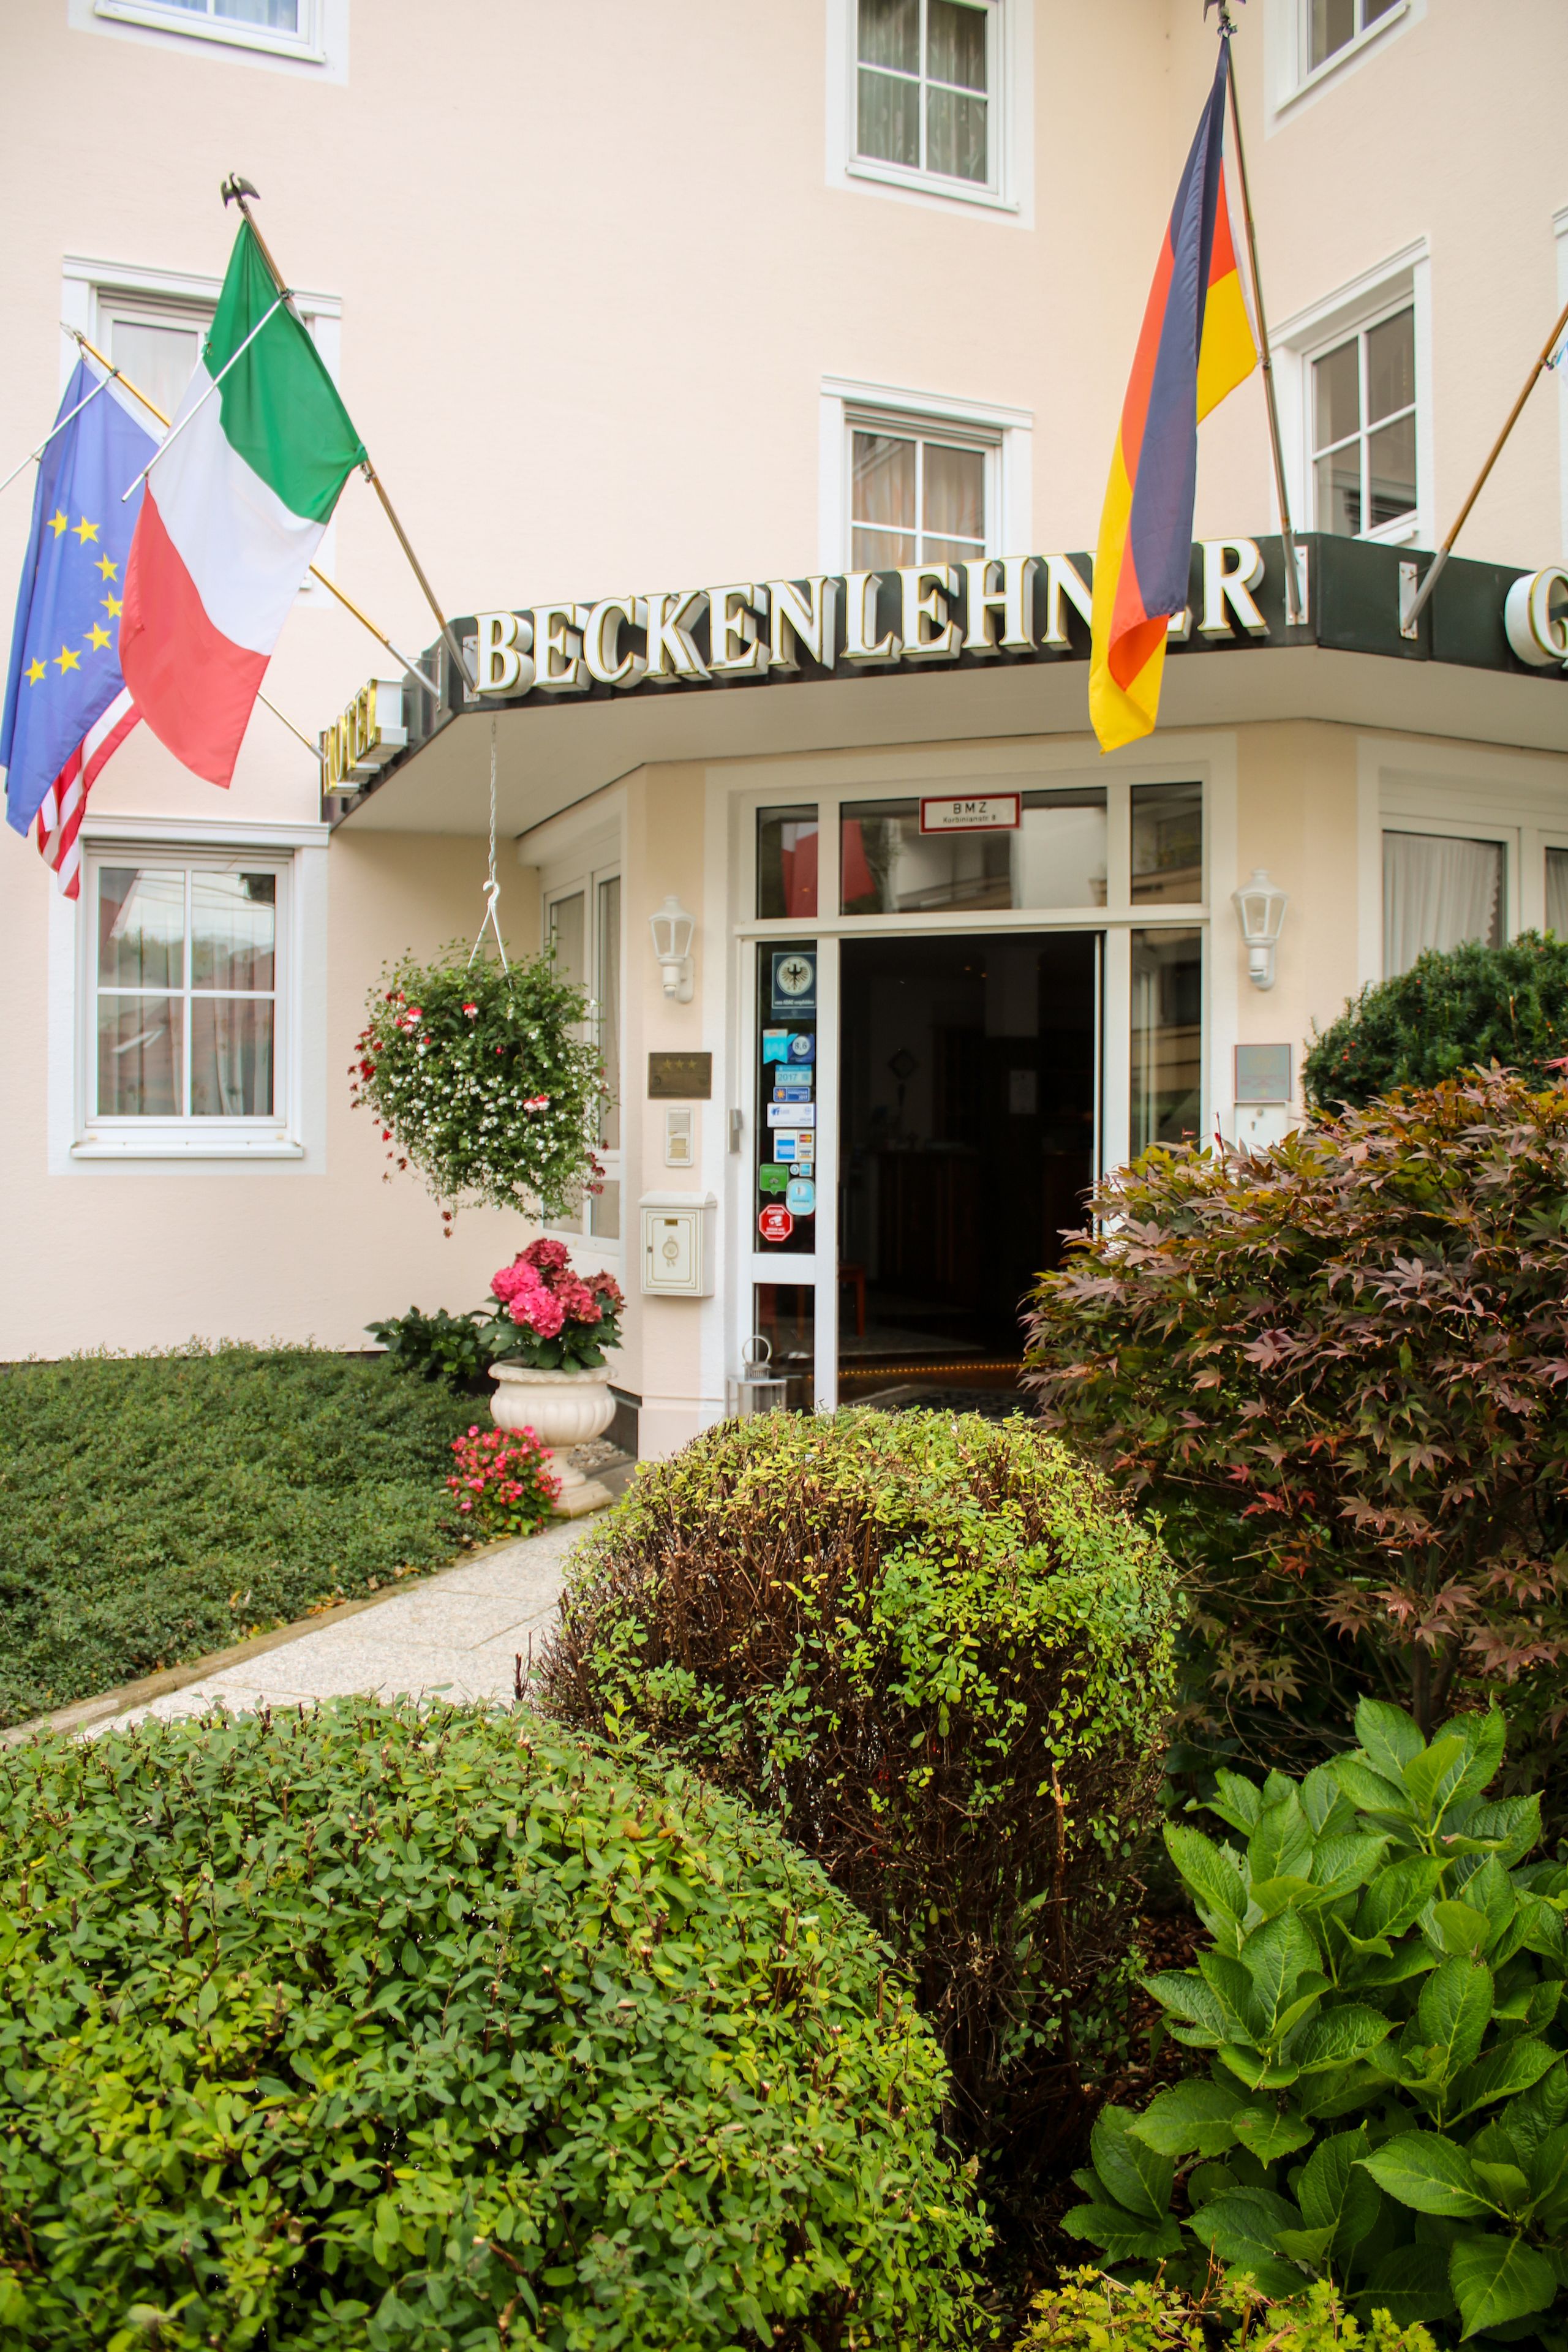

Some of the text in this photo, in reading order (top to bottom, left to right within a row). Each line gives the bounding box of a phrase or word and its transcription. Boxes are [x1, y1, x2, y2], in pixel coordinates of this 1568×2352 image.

[473, 537, 1270, 697] BECKENLEHNR
[323, 678, 393, 796] HOTEL
[778, 1073, 797, 1082] 2017
